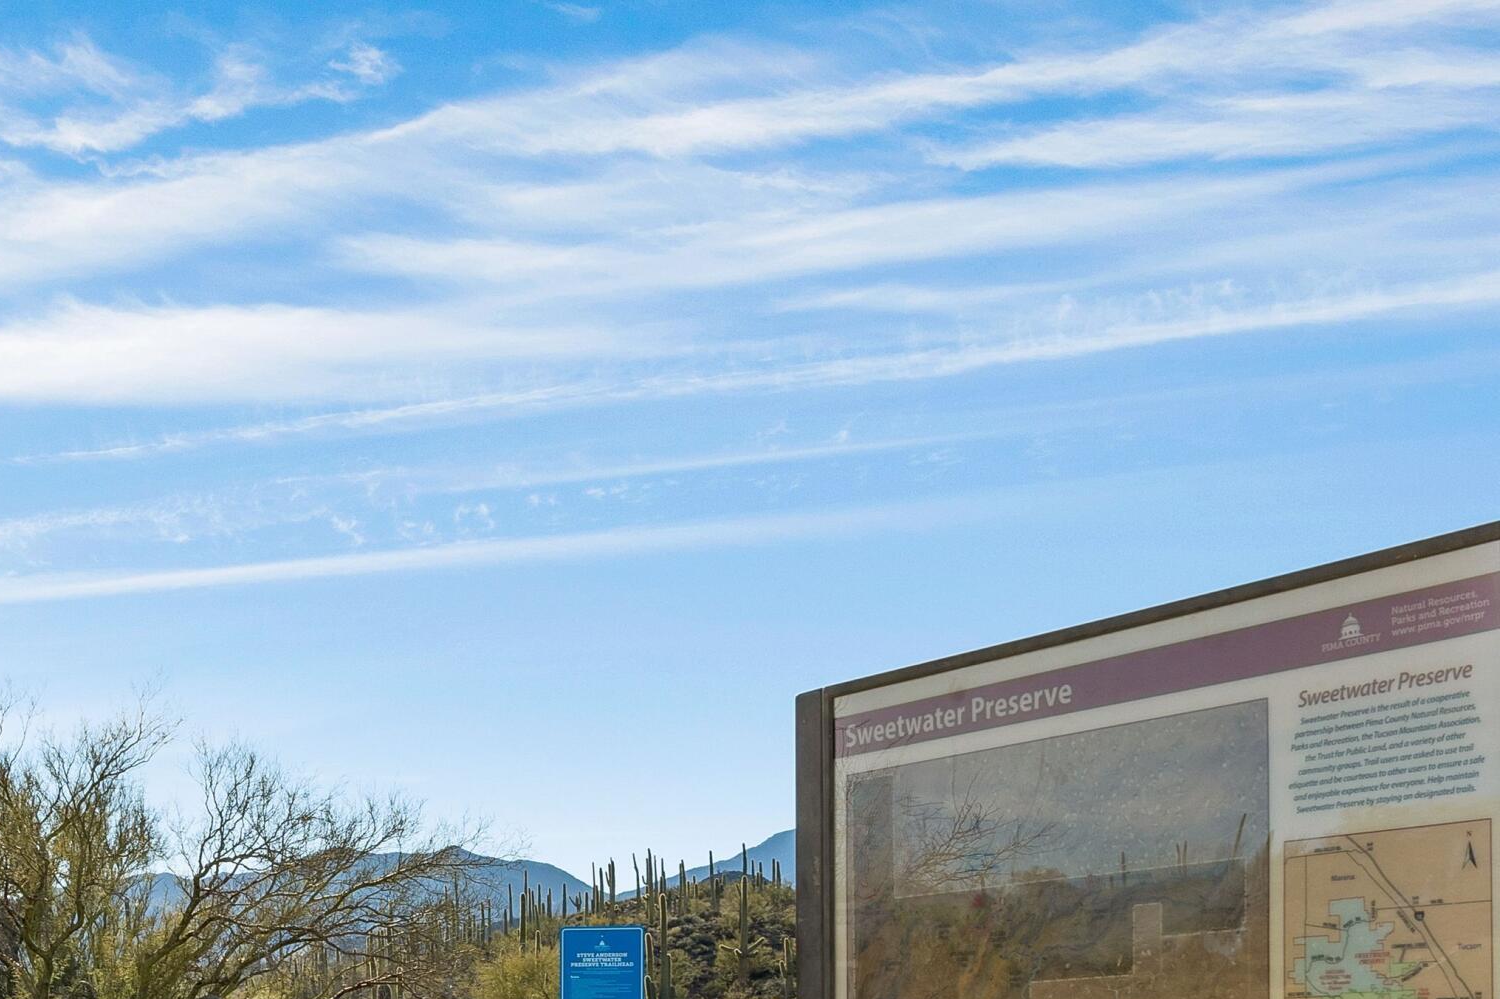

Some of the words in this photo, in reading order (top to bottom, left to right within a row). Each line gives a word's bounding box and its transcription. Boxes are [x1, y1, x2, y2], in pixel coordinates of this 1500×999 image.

[1391, 599, 1426, 613] Natural
[1391, 612, 1415, 625] Parks
[1419, 607, 1436, 619] and
[1439, 597, 1490, 616] Recreation
[1322, 639, 1345, 653] PIMA
[1345, 633, 1382, 648] COUNTY
[1298, 676, 1395, 708] Sweetwater
[1398, 663, 1473, 691] Preserve
[845, 704, 966, 748] Sweetwater
[971, 683, 1073, 723] Preserve
[1300, 711, 1339, 725] Sweetwater
[1340, 706, 1369, 718] Preserve
[1377, 703, 1388, 712] the
[1390, 699, 1410, 709] result
[1426, 688, 1469, 705] cooperative
[1290, 742, 1307, 751] Parks
[1309, 740, 1322, 748] and
[1361, 731, 1372, 740] the
[1374, 727, 1397, 738] Tucson
[1399, 721, 1436, 734] Mountains
[1294, 725, 1333, 740] partnership
[1334, 720, 1363, 732] between
[1365, 717, 1382, 727] Pima
[1384, 712, 1408, 725] County
[1411, 707, 1438, 719] Natural
[1298, 763, 1334, 777] community
[1364, 757, 1378, 766] Trail
[1380, 755, 1398, 763] users
[1399, 753, 1411, 761] are
[1412, 748, 1434, 759] asked
[1444, 746, 1457, 754] use
[1459, 743, 1474, 752] trail
[1305, 753, 1315, 762] the
[1317, 751, 1333, 760] Trust
[1334, 749, 1344, 757] for
[1346, 746, 1365, 756] Public
[1389, 740, 1403, 749] and
[1410, 735, 1434, 748] variety
[1445, 730, 1465, 741] other
[1288, 778, 1317, 791] etiquette
[1319, 776, 1332, 785] and
[1343, 770, 1377, 782] courteous
[1387, 766, 1406, 776] other
[1408, 764, 1426, 773] users
[1437, 760, 1461, 769] ensure
[1469, 755, 1484, 764] safe
[1293, 792, 1307, 800] and
[1308, 788, 1340, 800] enjoyable
[1341, 783, 1378, 796] experience
[1379, 781, 1389, 789] for
[1427, 774, 1444, 785] Help
[1445, 769, 1479, 781] maintain
[1296, 801, 1334, 813] Sweetwater
[1336, 797, 1364, 808] Preserve
[1375, 793, 1401, 805] staying
[1414, 786, 1454, 800] designated
[1457, 942, 1482, 950] Tucson
